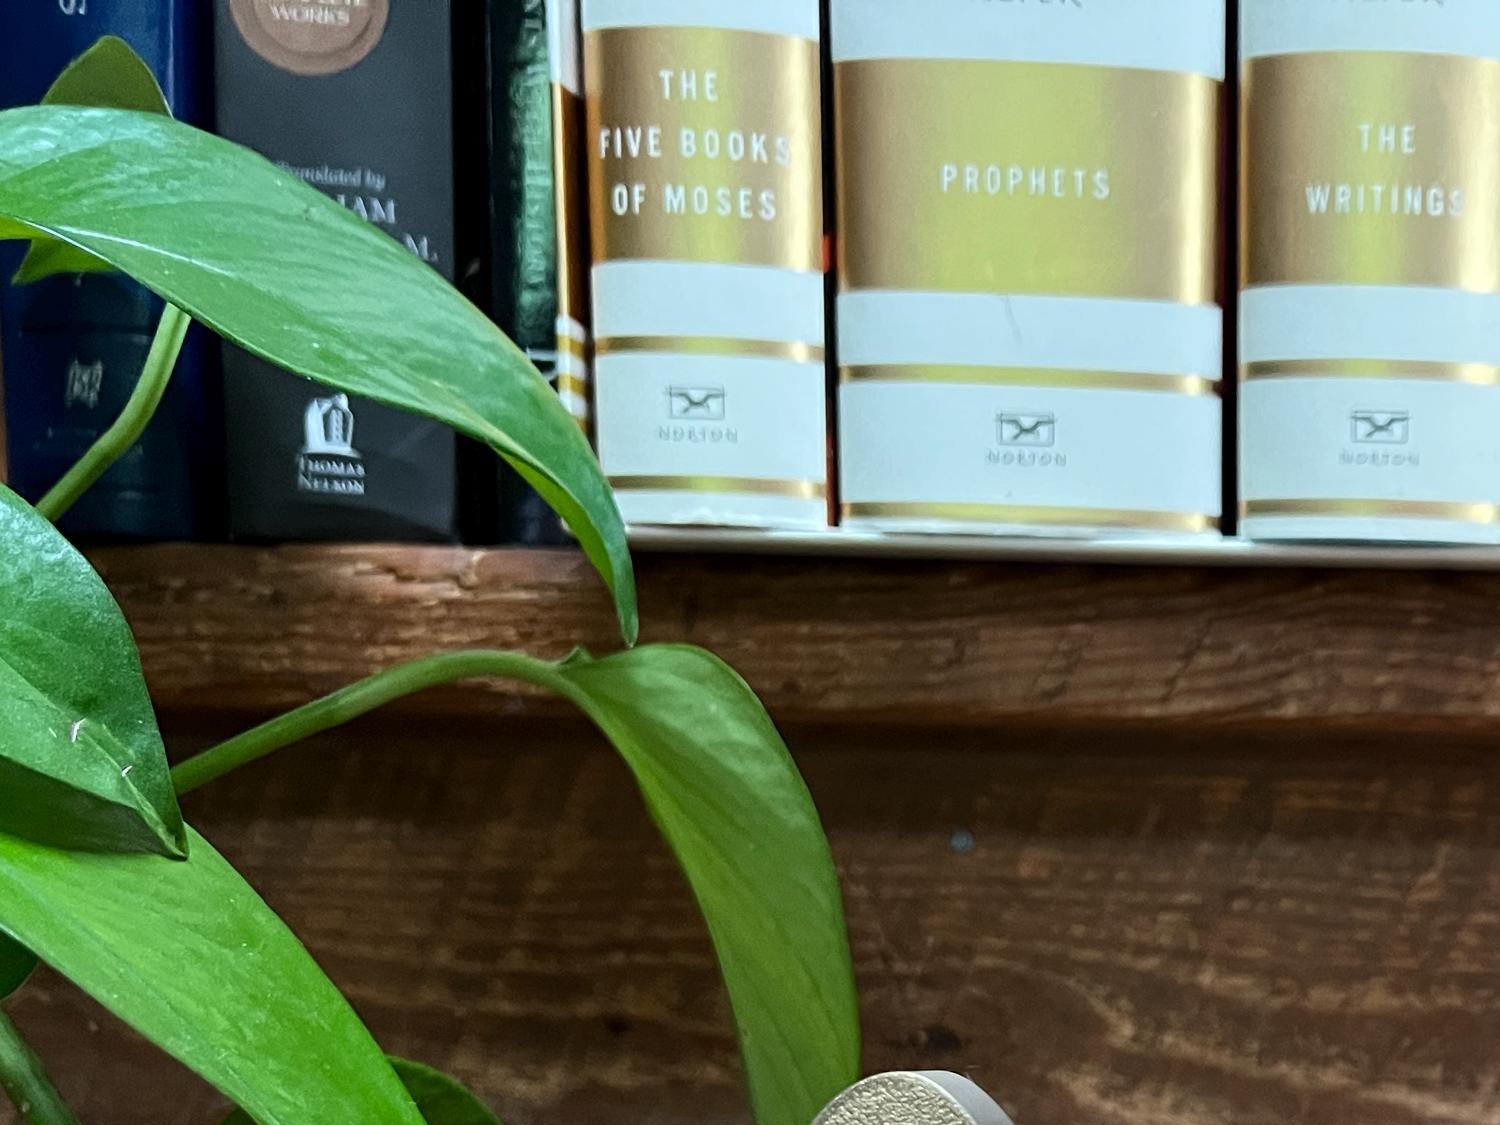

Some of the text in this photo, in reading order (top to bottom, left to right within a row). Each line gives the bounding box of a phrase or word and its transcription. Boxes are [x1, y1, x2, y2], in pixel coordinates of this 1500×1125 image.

[659, 69, 718, 103] THE
[599, 126, 793, 168] FIVE BOOKS
[1357, 123, 1416, 154] THE
[940, 163, 1110, 199] PROPHETS
[612, 183, 777, 221] OF MOSES
[1305, 183, 1467, 217] WRITINGS
